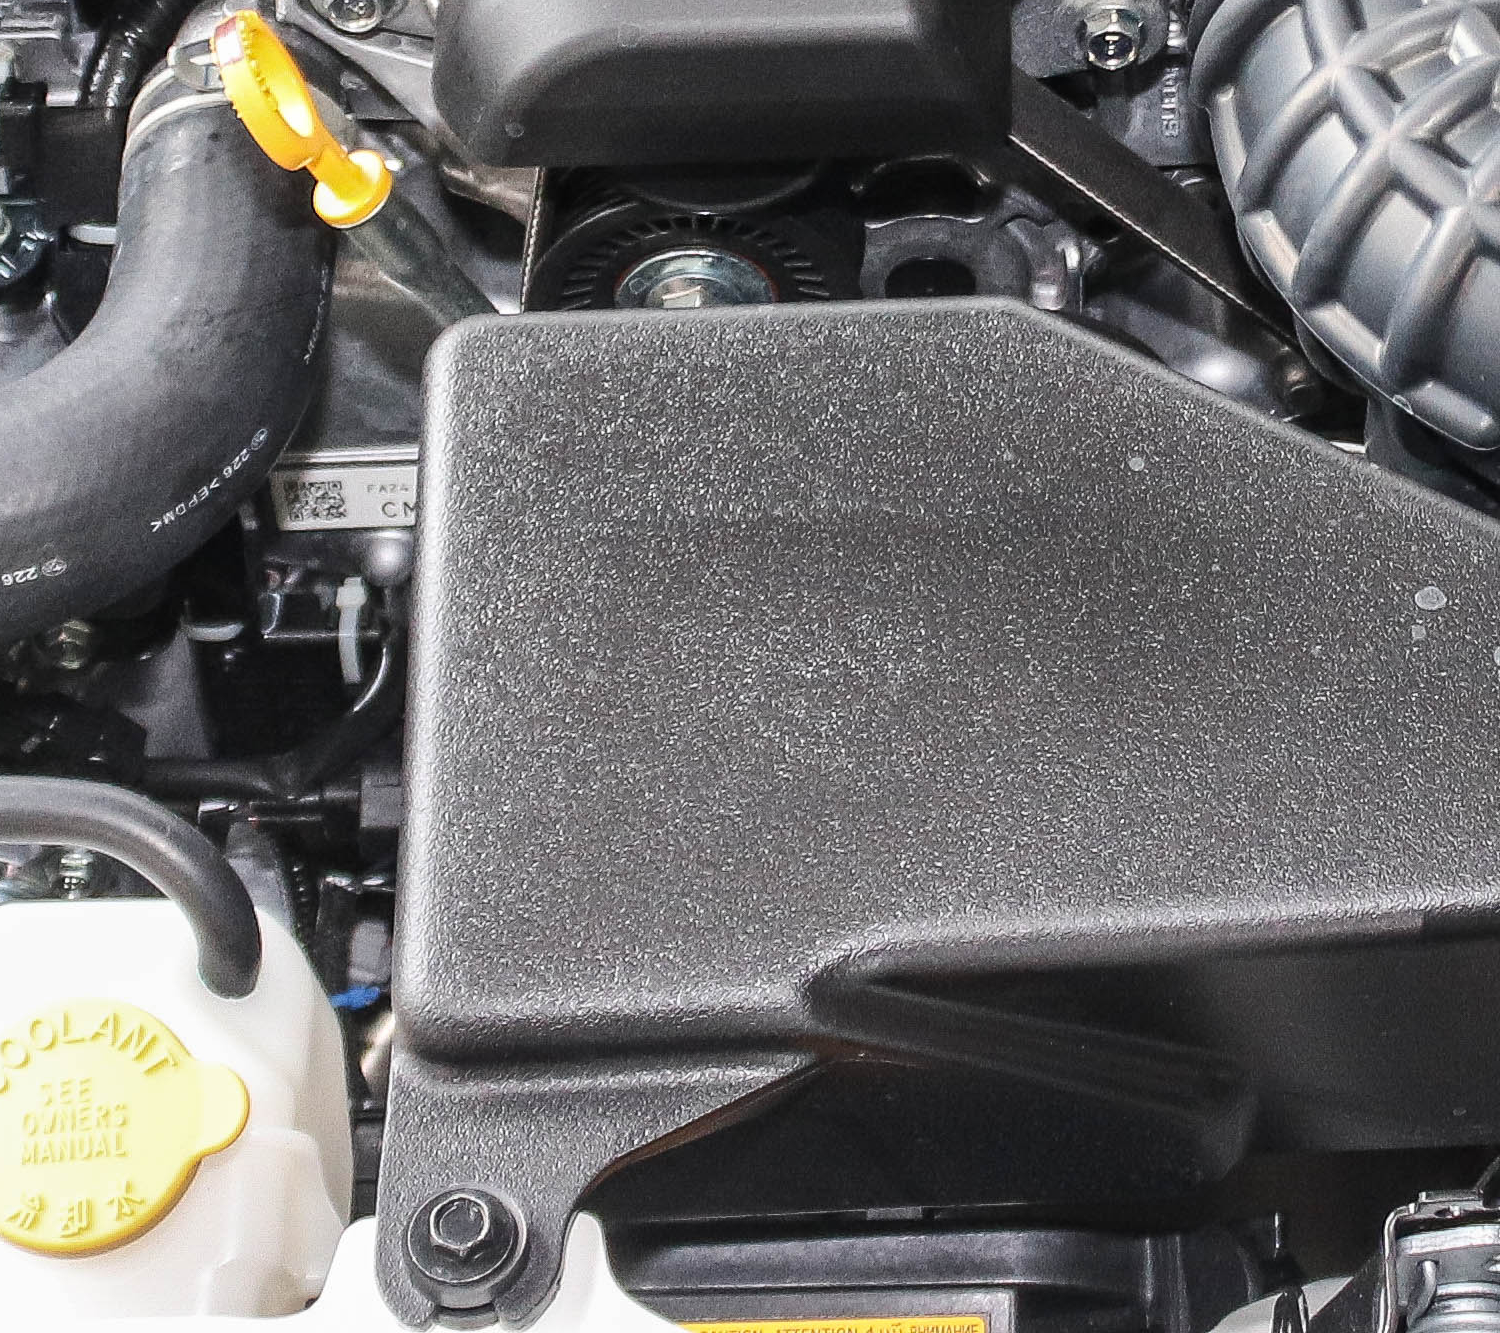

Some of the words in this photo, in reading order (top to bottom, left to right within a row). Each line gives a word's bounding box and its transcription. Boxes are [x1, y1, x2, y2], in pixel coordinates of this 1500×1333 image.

[222, 448, 250, 479] 226
[1, 566, 40, 587] 226
[40, 1077, 93, 1107] SEE
[20, 1131, 130, 1166] MANUAL
